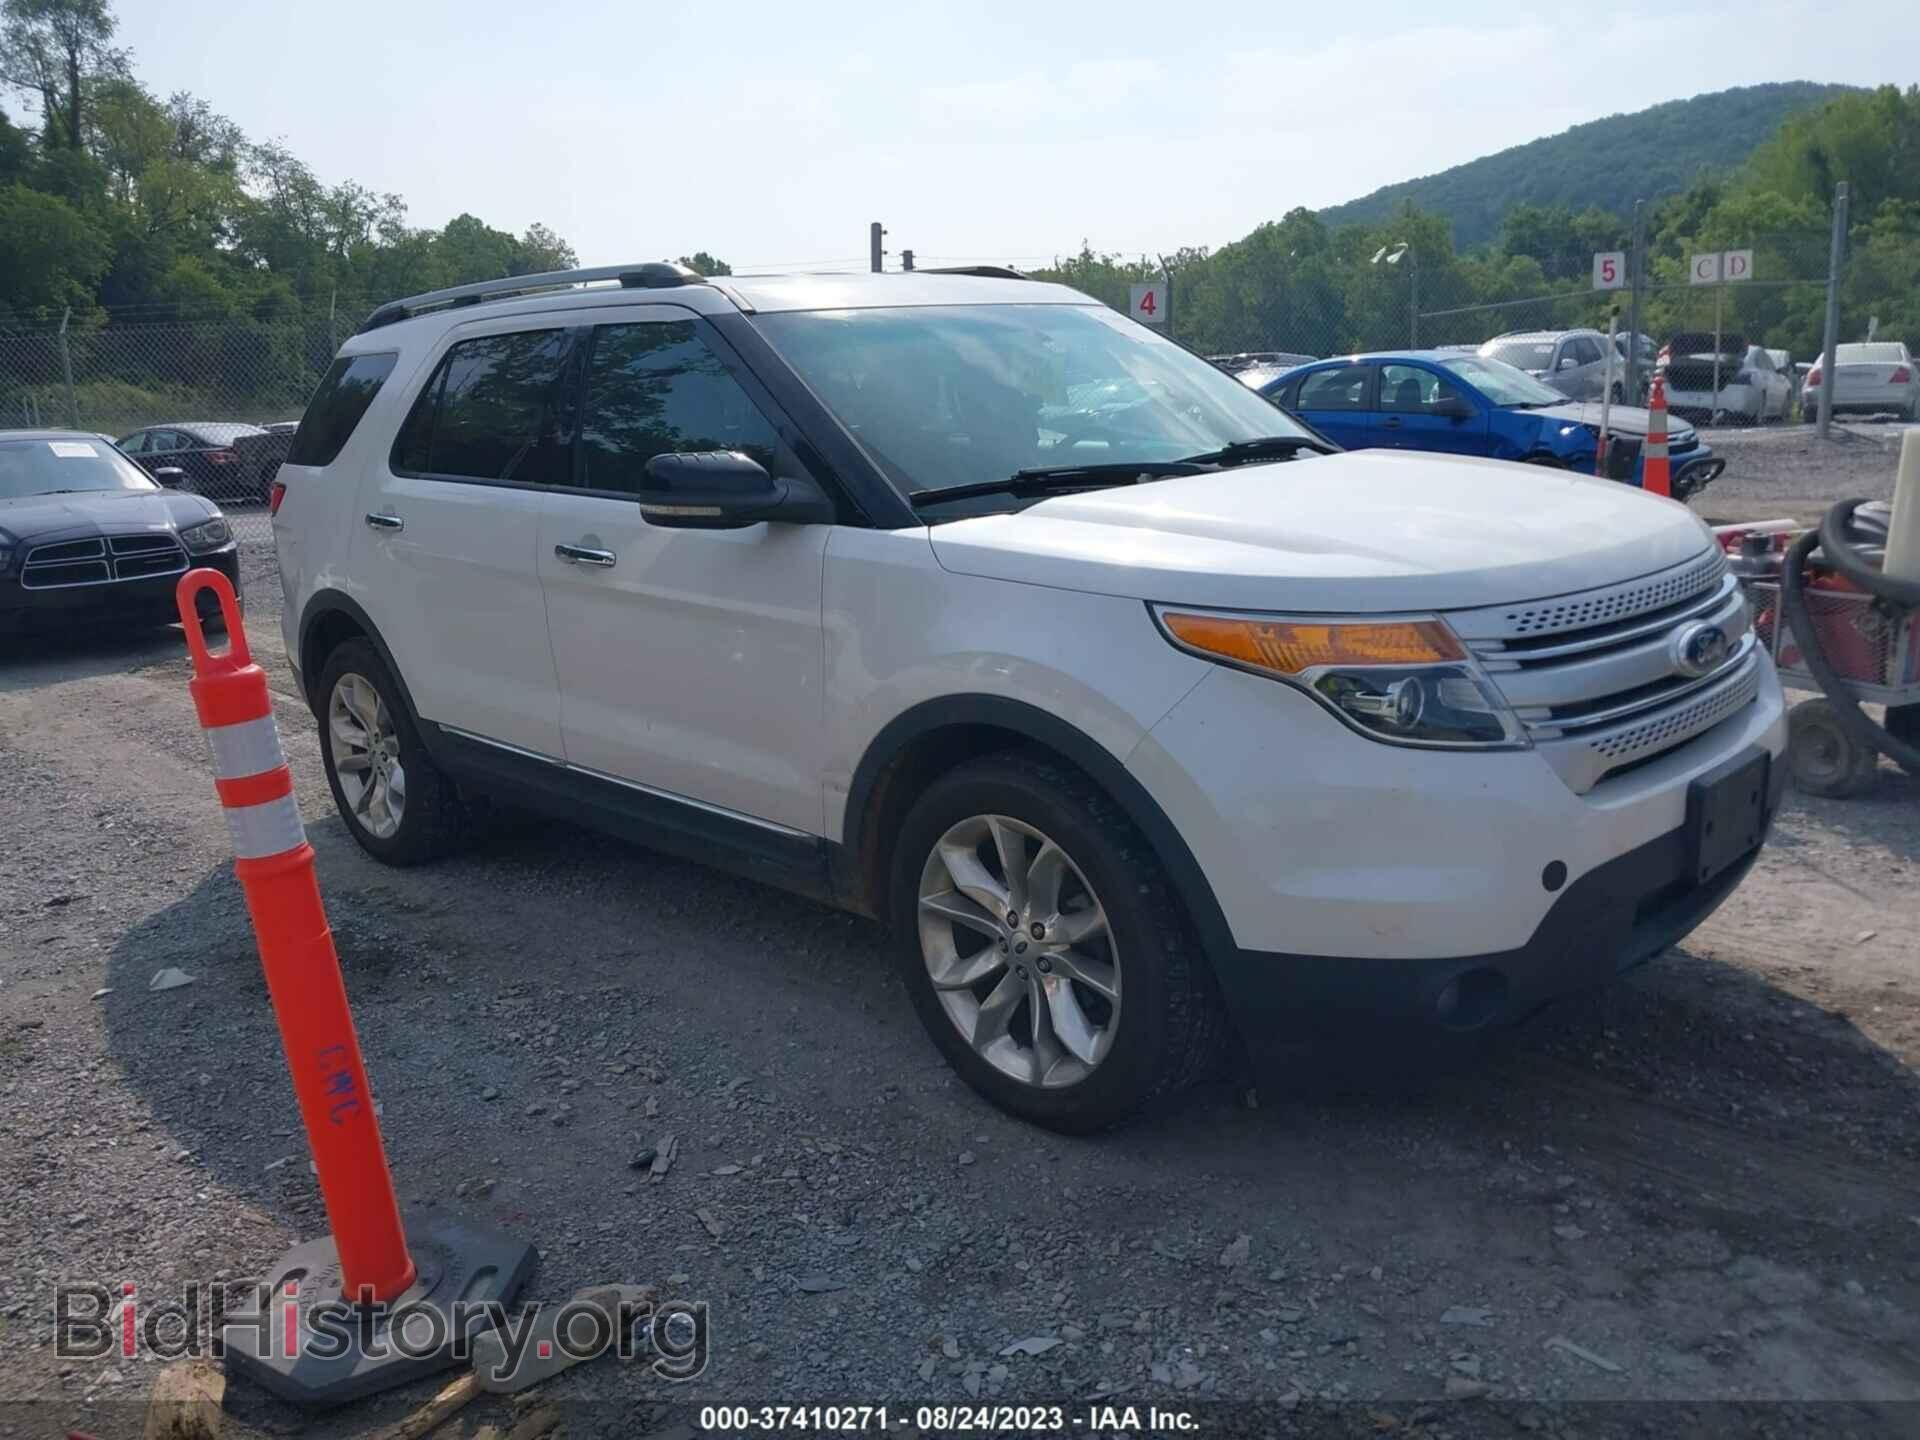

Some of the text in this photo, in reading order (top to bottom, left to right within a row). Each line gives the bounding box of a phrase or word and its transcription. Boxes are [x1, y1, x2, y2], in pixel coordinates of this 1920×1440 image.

[1602, 259, 1616, 282] 5
[1696, 258, 1713, 279] C
[1729, 255, 1746, 275] D
[1140, 290, 1156, 316] 4
